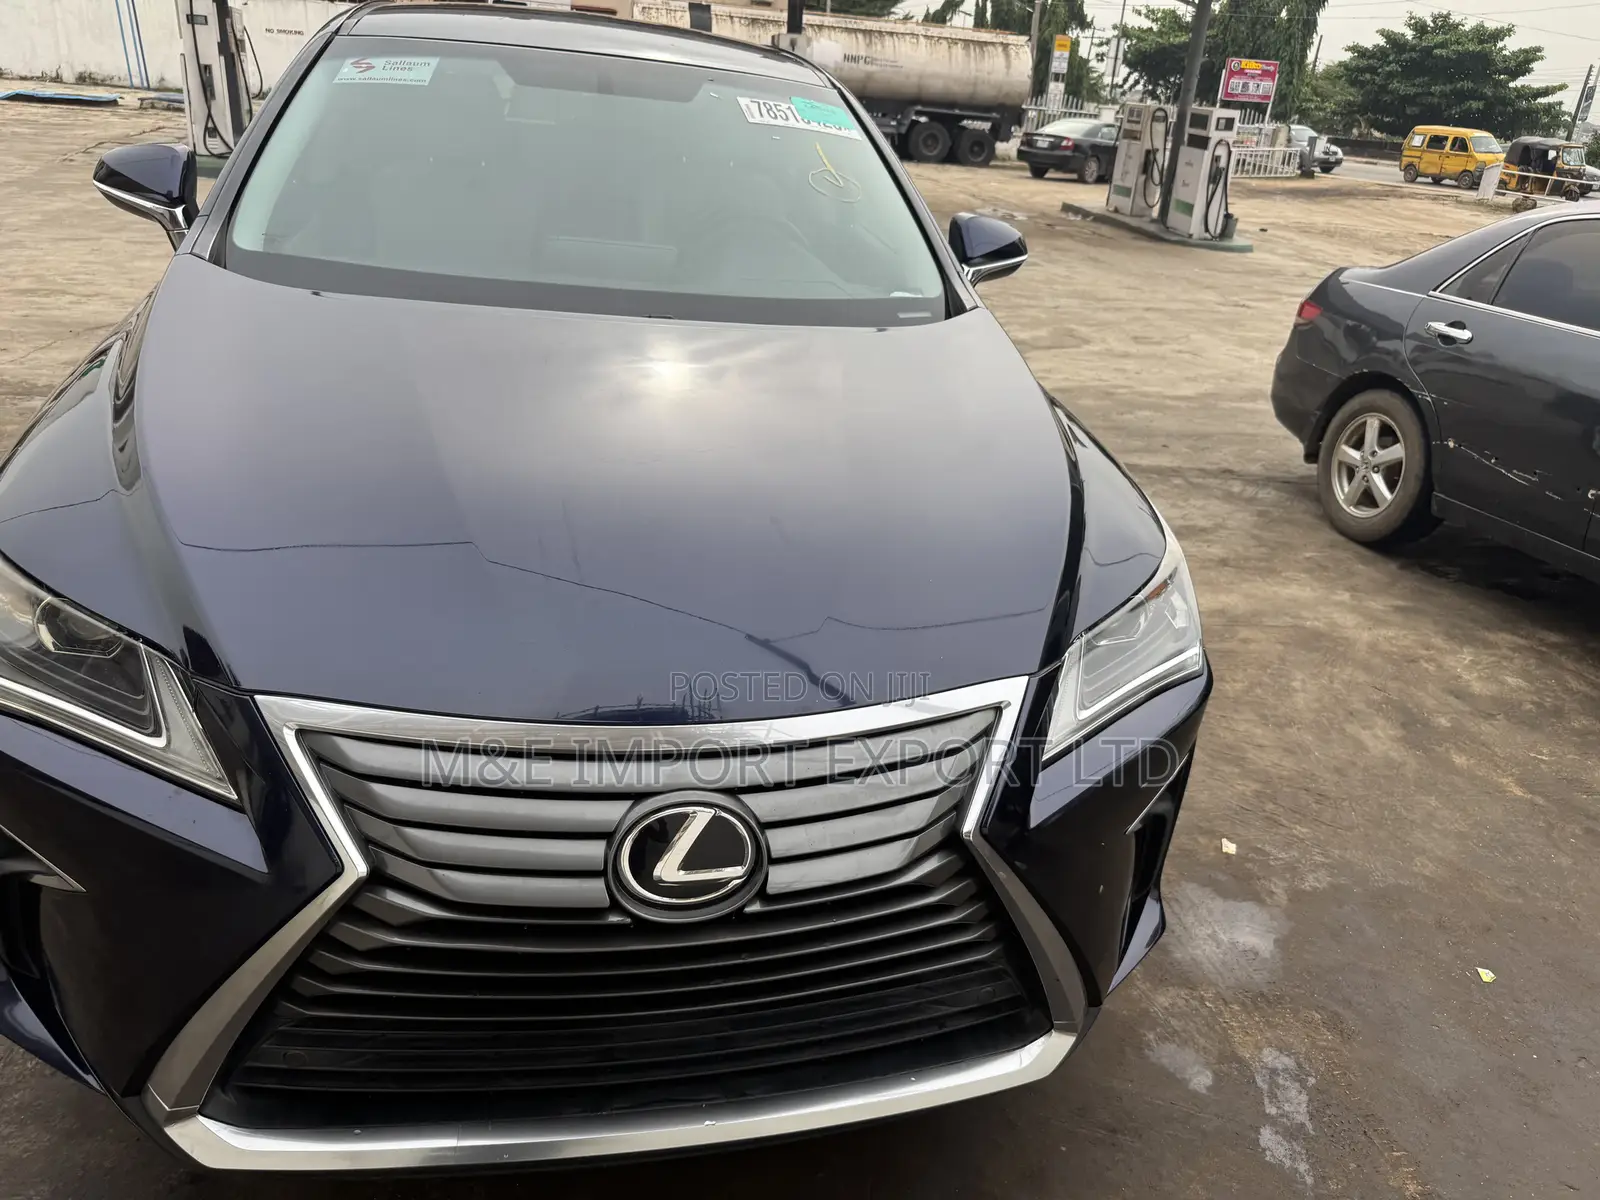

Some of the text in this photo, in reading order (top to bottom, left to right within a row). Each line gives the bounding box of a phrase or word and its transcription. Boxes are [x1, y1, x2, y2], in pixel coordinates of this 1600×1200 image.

[843, 53, 871, 66] NNPC
[381, 65, 413, 73] Lines
[337, 75, 427, 84] www.sallaumlines.com
